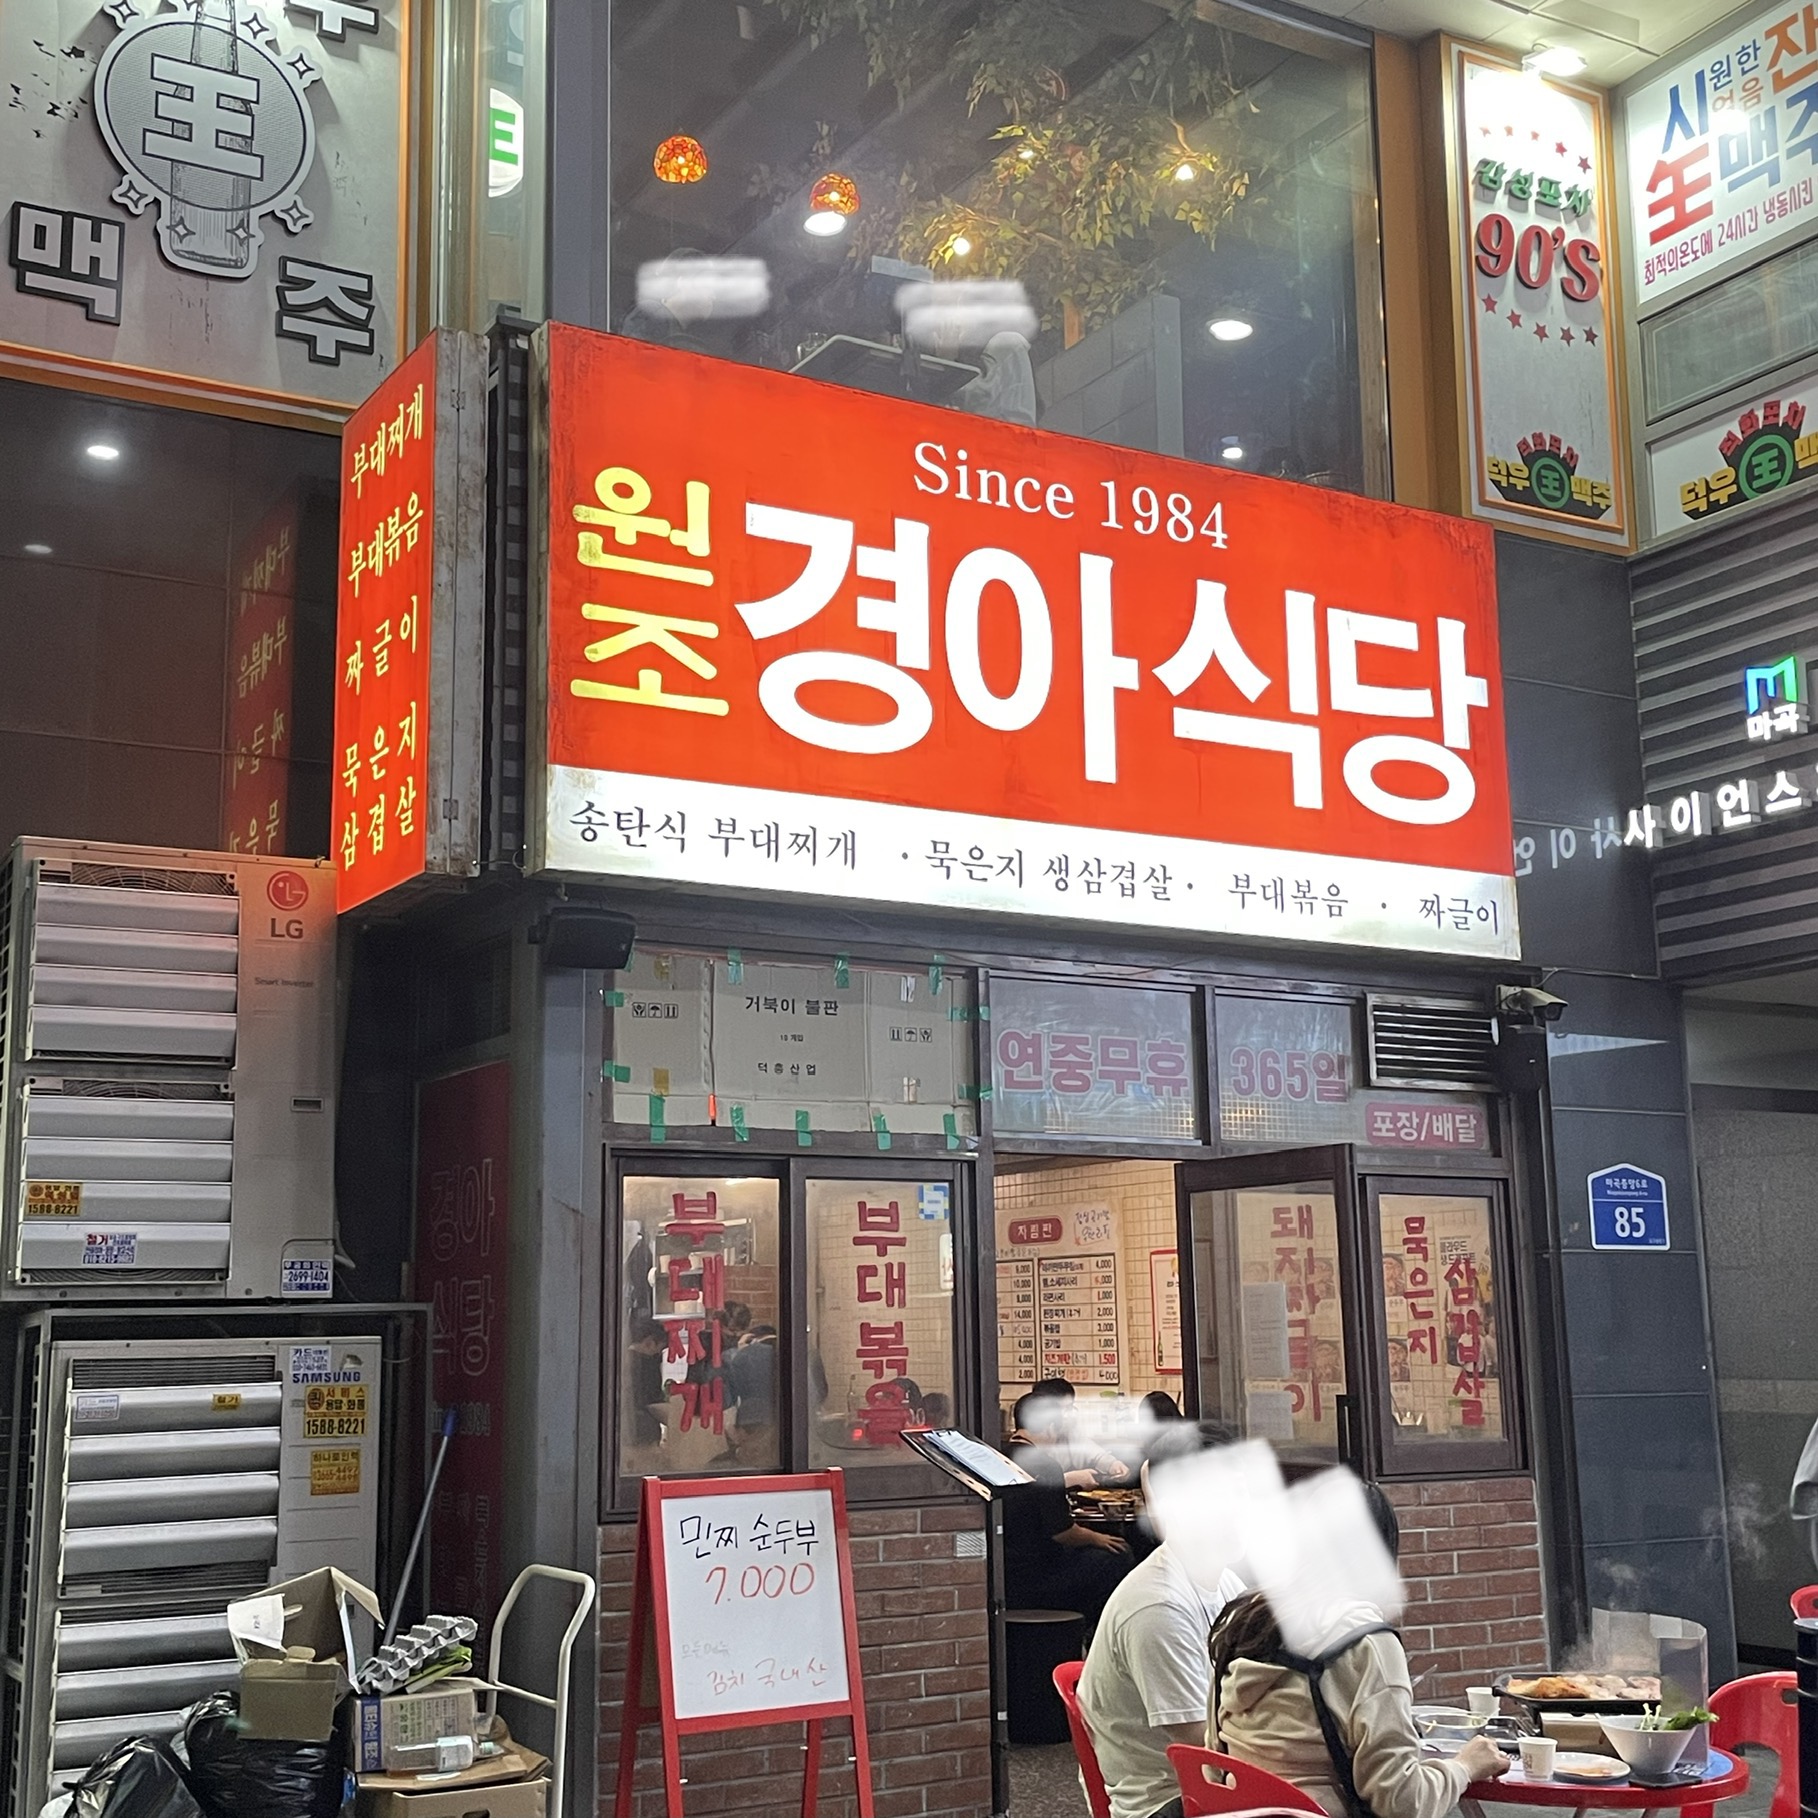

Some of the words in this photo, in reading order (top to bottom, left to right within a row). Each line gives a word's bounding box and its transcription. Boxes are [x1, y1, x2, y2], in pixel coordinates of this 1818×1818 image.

[1718, 205, 1759, 247] 24시간
[350, 384, 424, 499] 부대찌개
[914, 441, 1074, 520] Since
[1101, 480, 1228, 549] 1984
[347, 491, 424, 598] 부대볶음
[570, 466, 730, 717] 원조
[344, 595, 419, 695] 짜글이
[733, 501, 1489, 827] 경아식당
[341, 701, 418, 798] 묵은지
[1747, 703, 1799, 740] 마곡
[339, 776, 418, 872] 삼겹살
[1623, 765, 1818, 849] 사이언스
[569, 801, 688, 854] 송탄식
[708, 817, 857, 870] 부대찌개
[924, 839, 1025, 889] 묵은지
[1043, 853, 1174, 903] 생삼겹살
[1228, 873, 1349, 919] 부대볶음
[1419, 894, 1499, 935] 짜글이
[270, 917, 304, 940] LG
[745, 995, 795, 1015] 거북이
[805, 999, 839, 1016] 불판
[998, 1029, 1189, 1100] 연중무휴
[1230, 1046, 1350, 1103] 365일
[1371, 1108, 1478, 1144] 포장/배달
[1614, 1206, 1646, 1238] 85
[1402, 1216, 1438, 1364] 묵은지
[292, 1371, 361, 1384] SAMSUNG
[326, 1387, 365, 1398] 서비스
[306, 1418, 366, 1436] 1588-8221
[680, 1515, 739, 1559] 민찌
[750, 1513, 819, 1556] 순두부
[707, 1669, 744, 1696] 김치
[755, 1656, 828, 1688] 국내산
